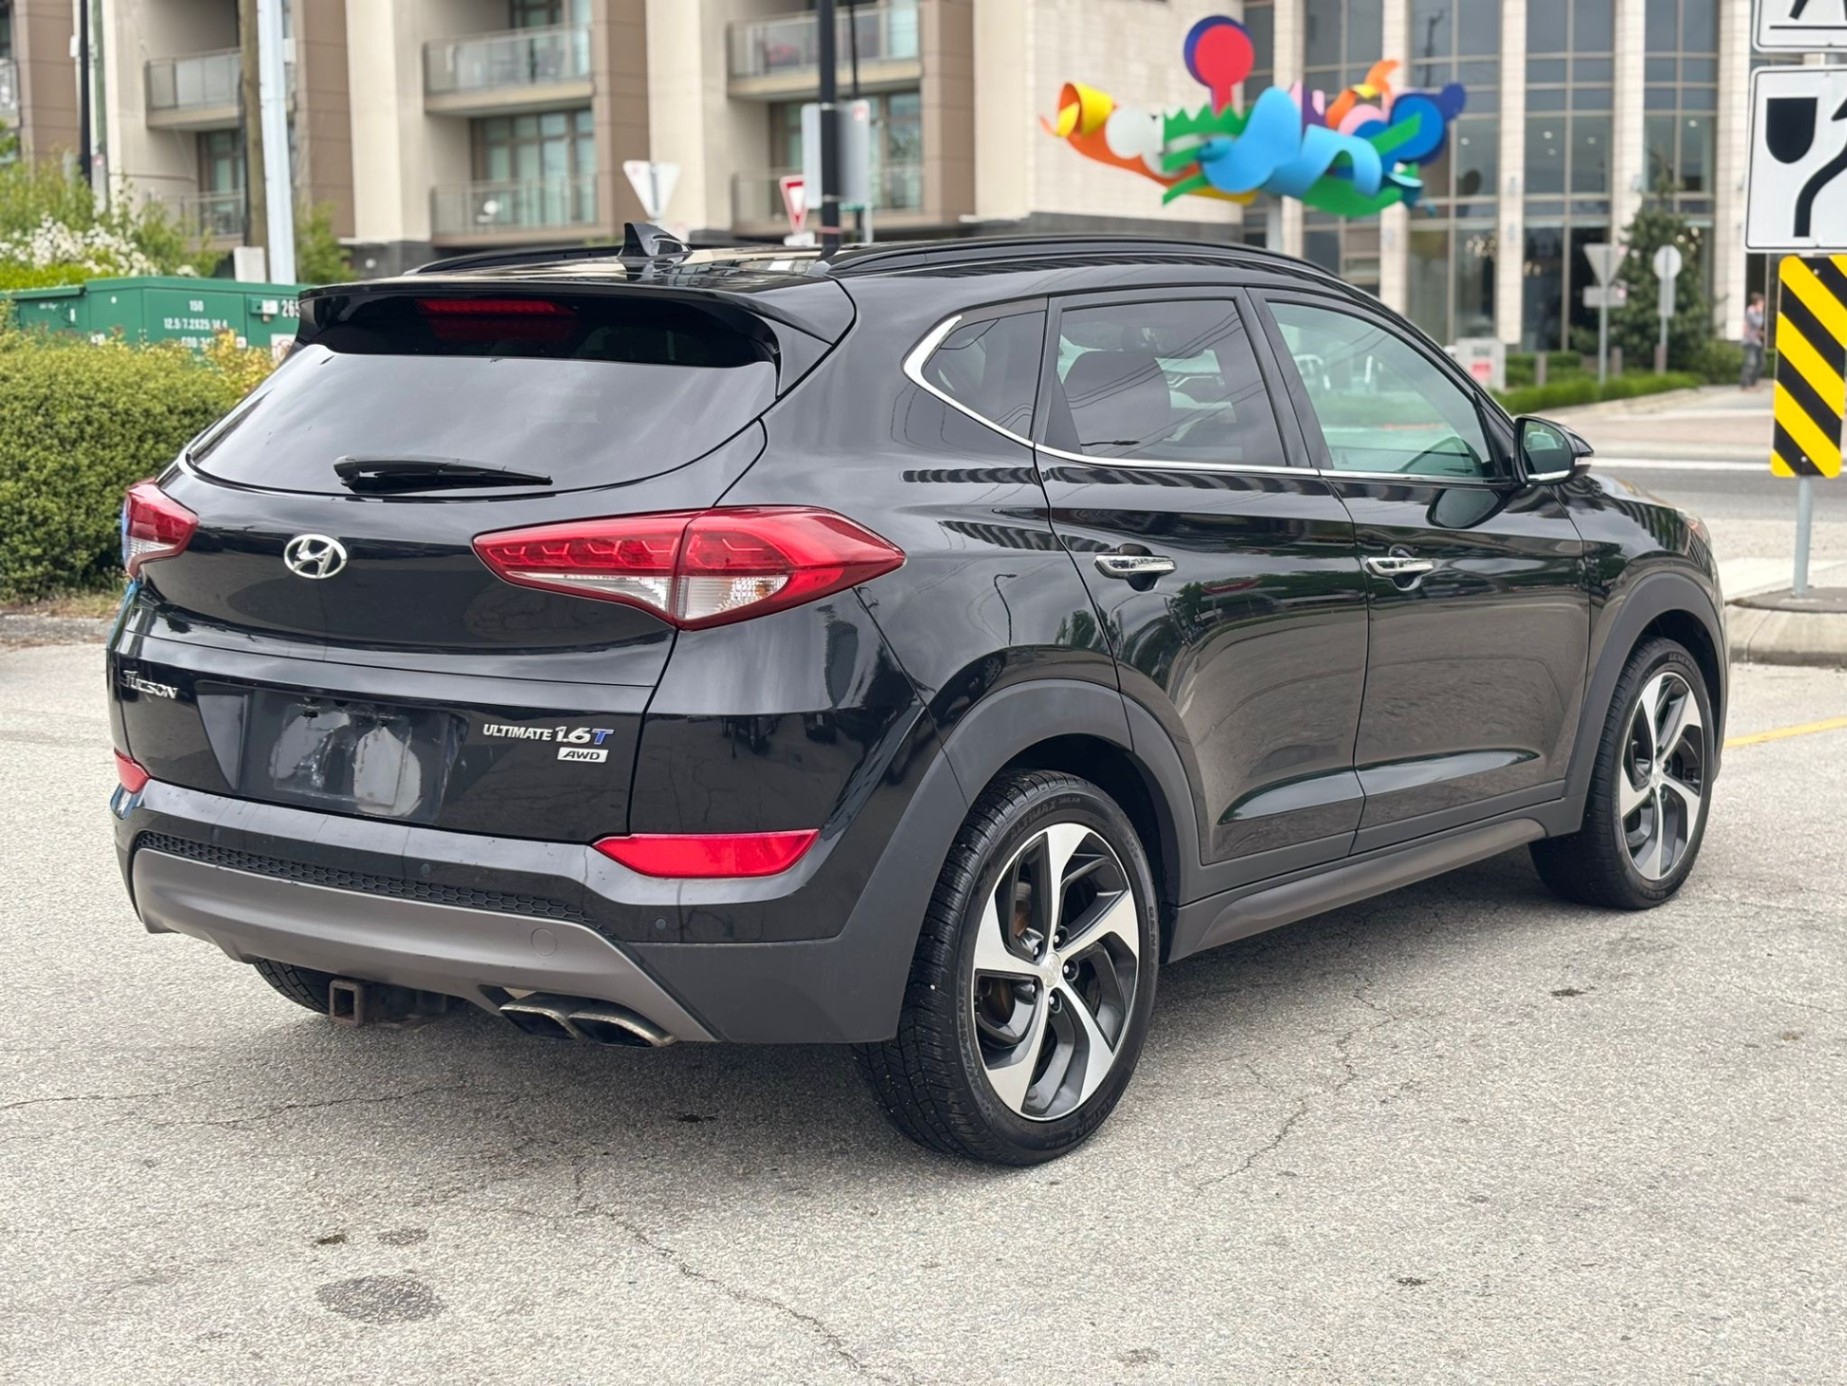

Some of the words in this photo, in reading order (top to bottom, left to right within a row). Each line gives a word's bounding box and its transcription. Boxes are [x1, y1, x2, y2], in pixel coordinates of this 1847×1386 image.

[123, 669, 179, 699] TUCSON
[482, 723, 554, 741] ULTIMATE
[555, 725, 615, 745] 1.6T
[562, 750, 601, 760] AWD
